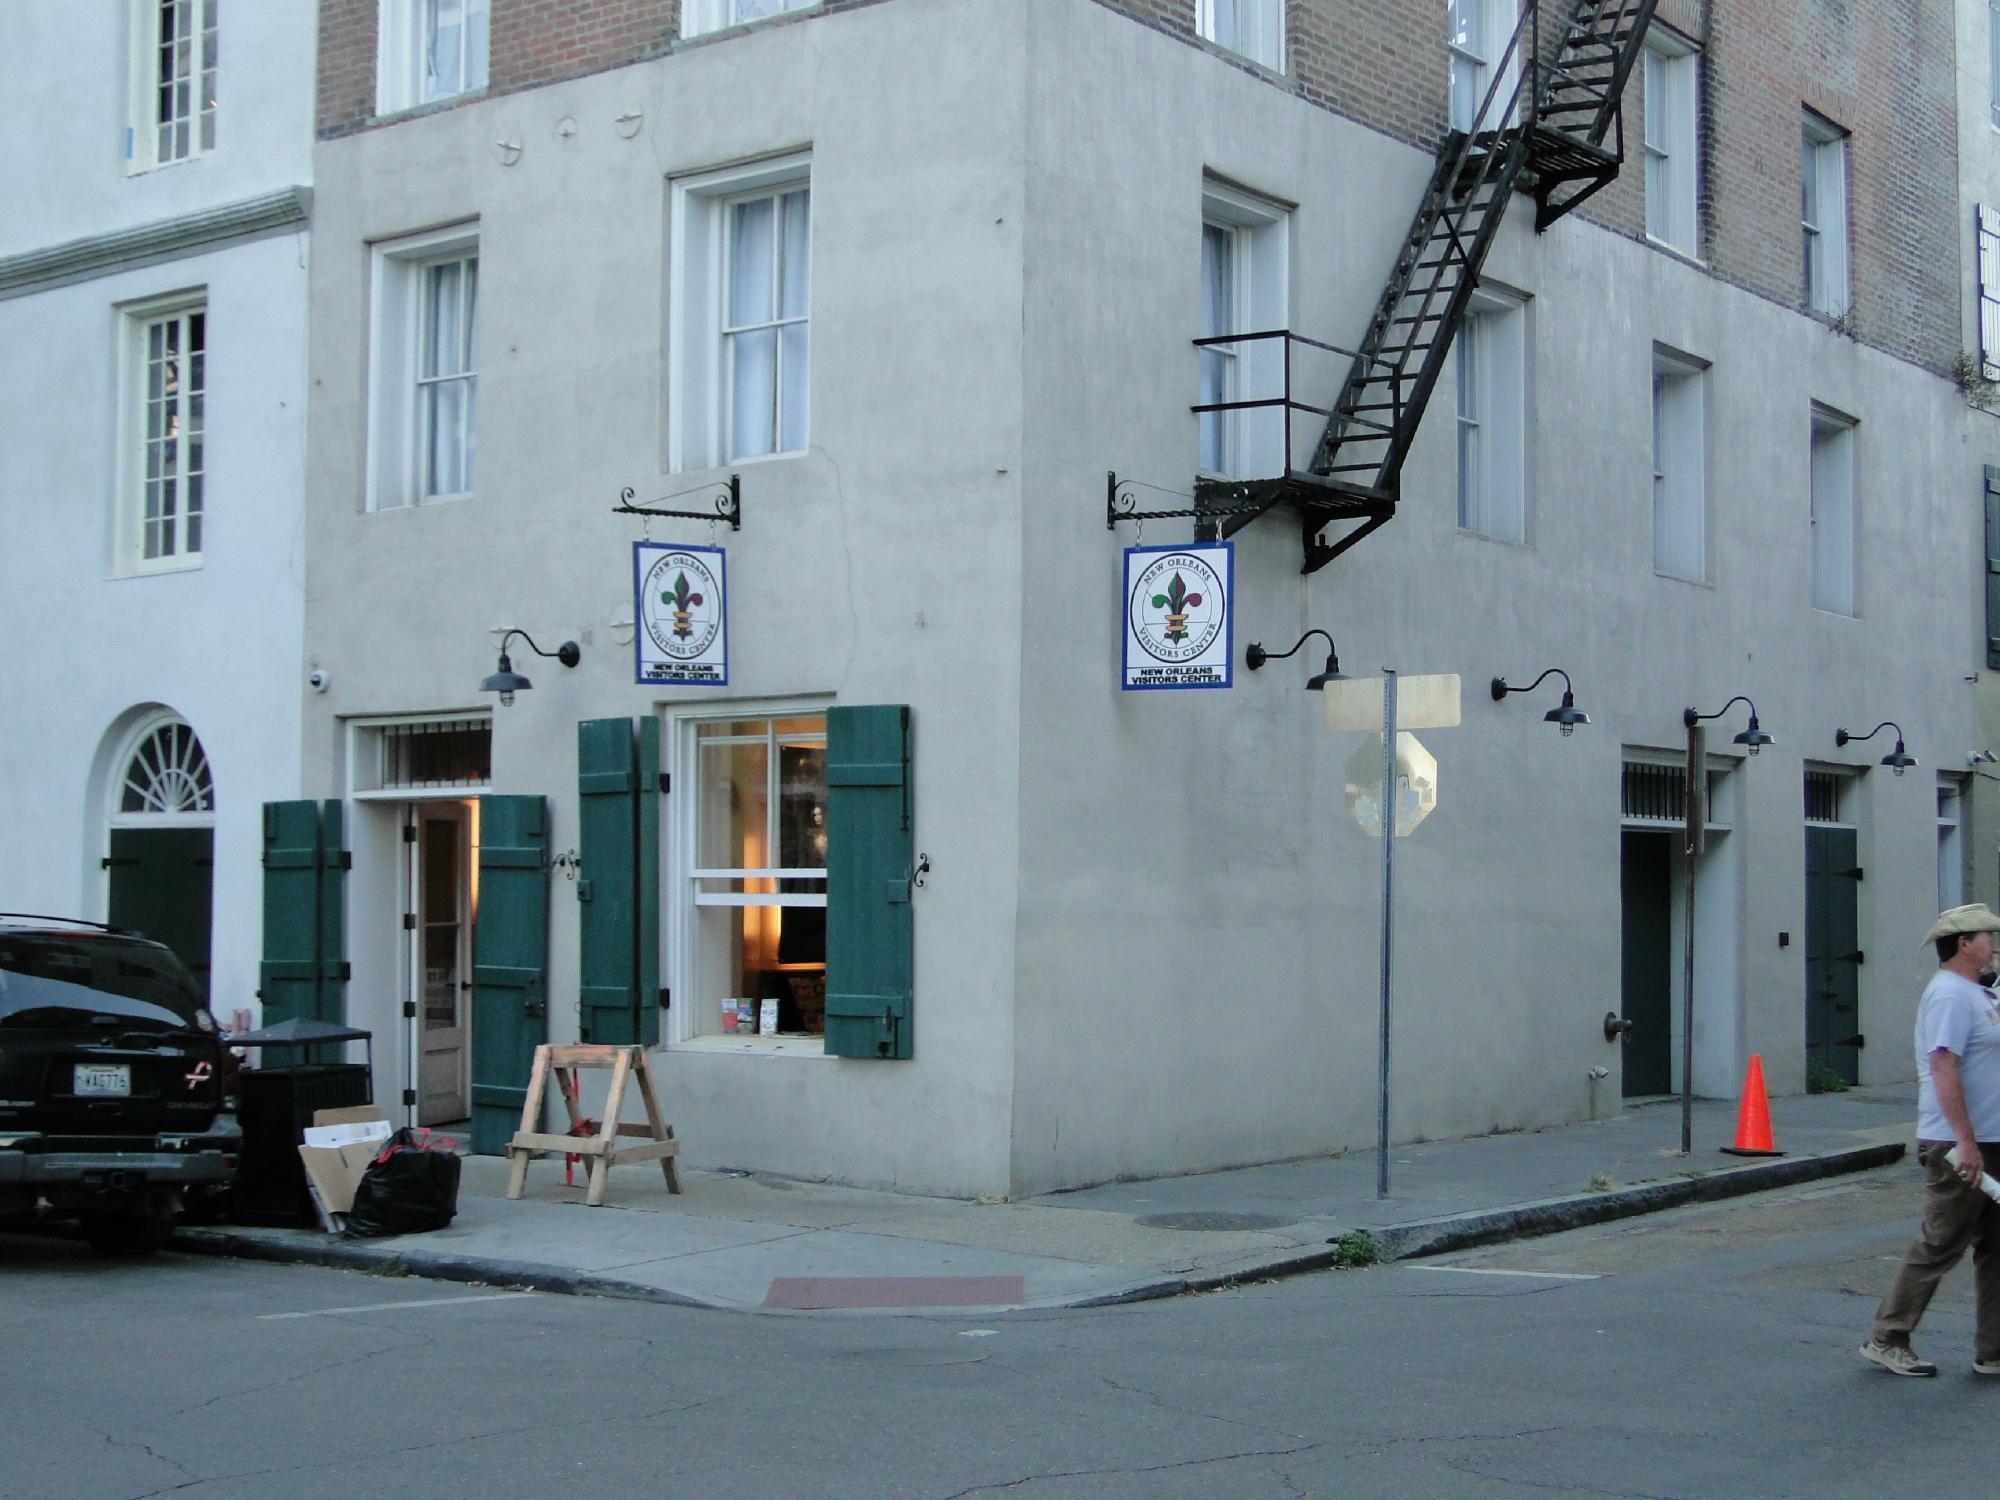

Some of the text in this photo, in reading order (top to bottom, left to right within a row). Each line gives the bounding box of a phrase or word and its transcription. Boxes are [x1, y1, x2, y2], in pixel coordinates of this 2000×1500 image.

[653, 557, 710, 582] NEW ORLEANS
[1143, 558, 1212, 584] NEW ORLEANS
[651, 622, 716, 655] VISITORS CENTER
[1138, 622, 1217, 659] VISITORS CENTER
[645, 670, 720, 680] VISITORS CENTER
[653, 663, 714, 672] NEW ORLEANS
[1140, 666, 1213, 676] NEW ORLEANS
[1131, 674, 1222, 685] VISITORS CENTER
